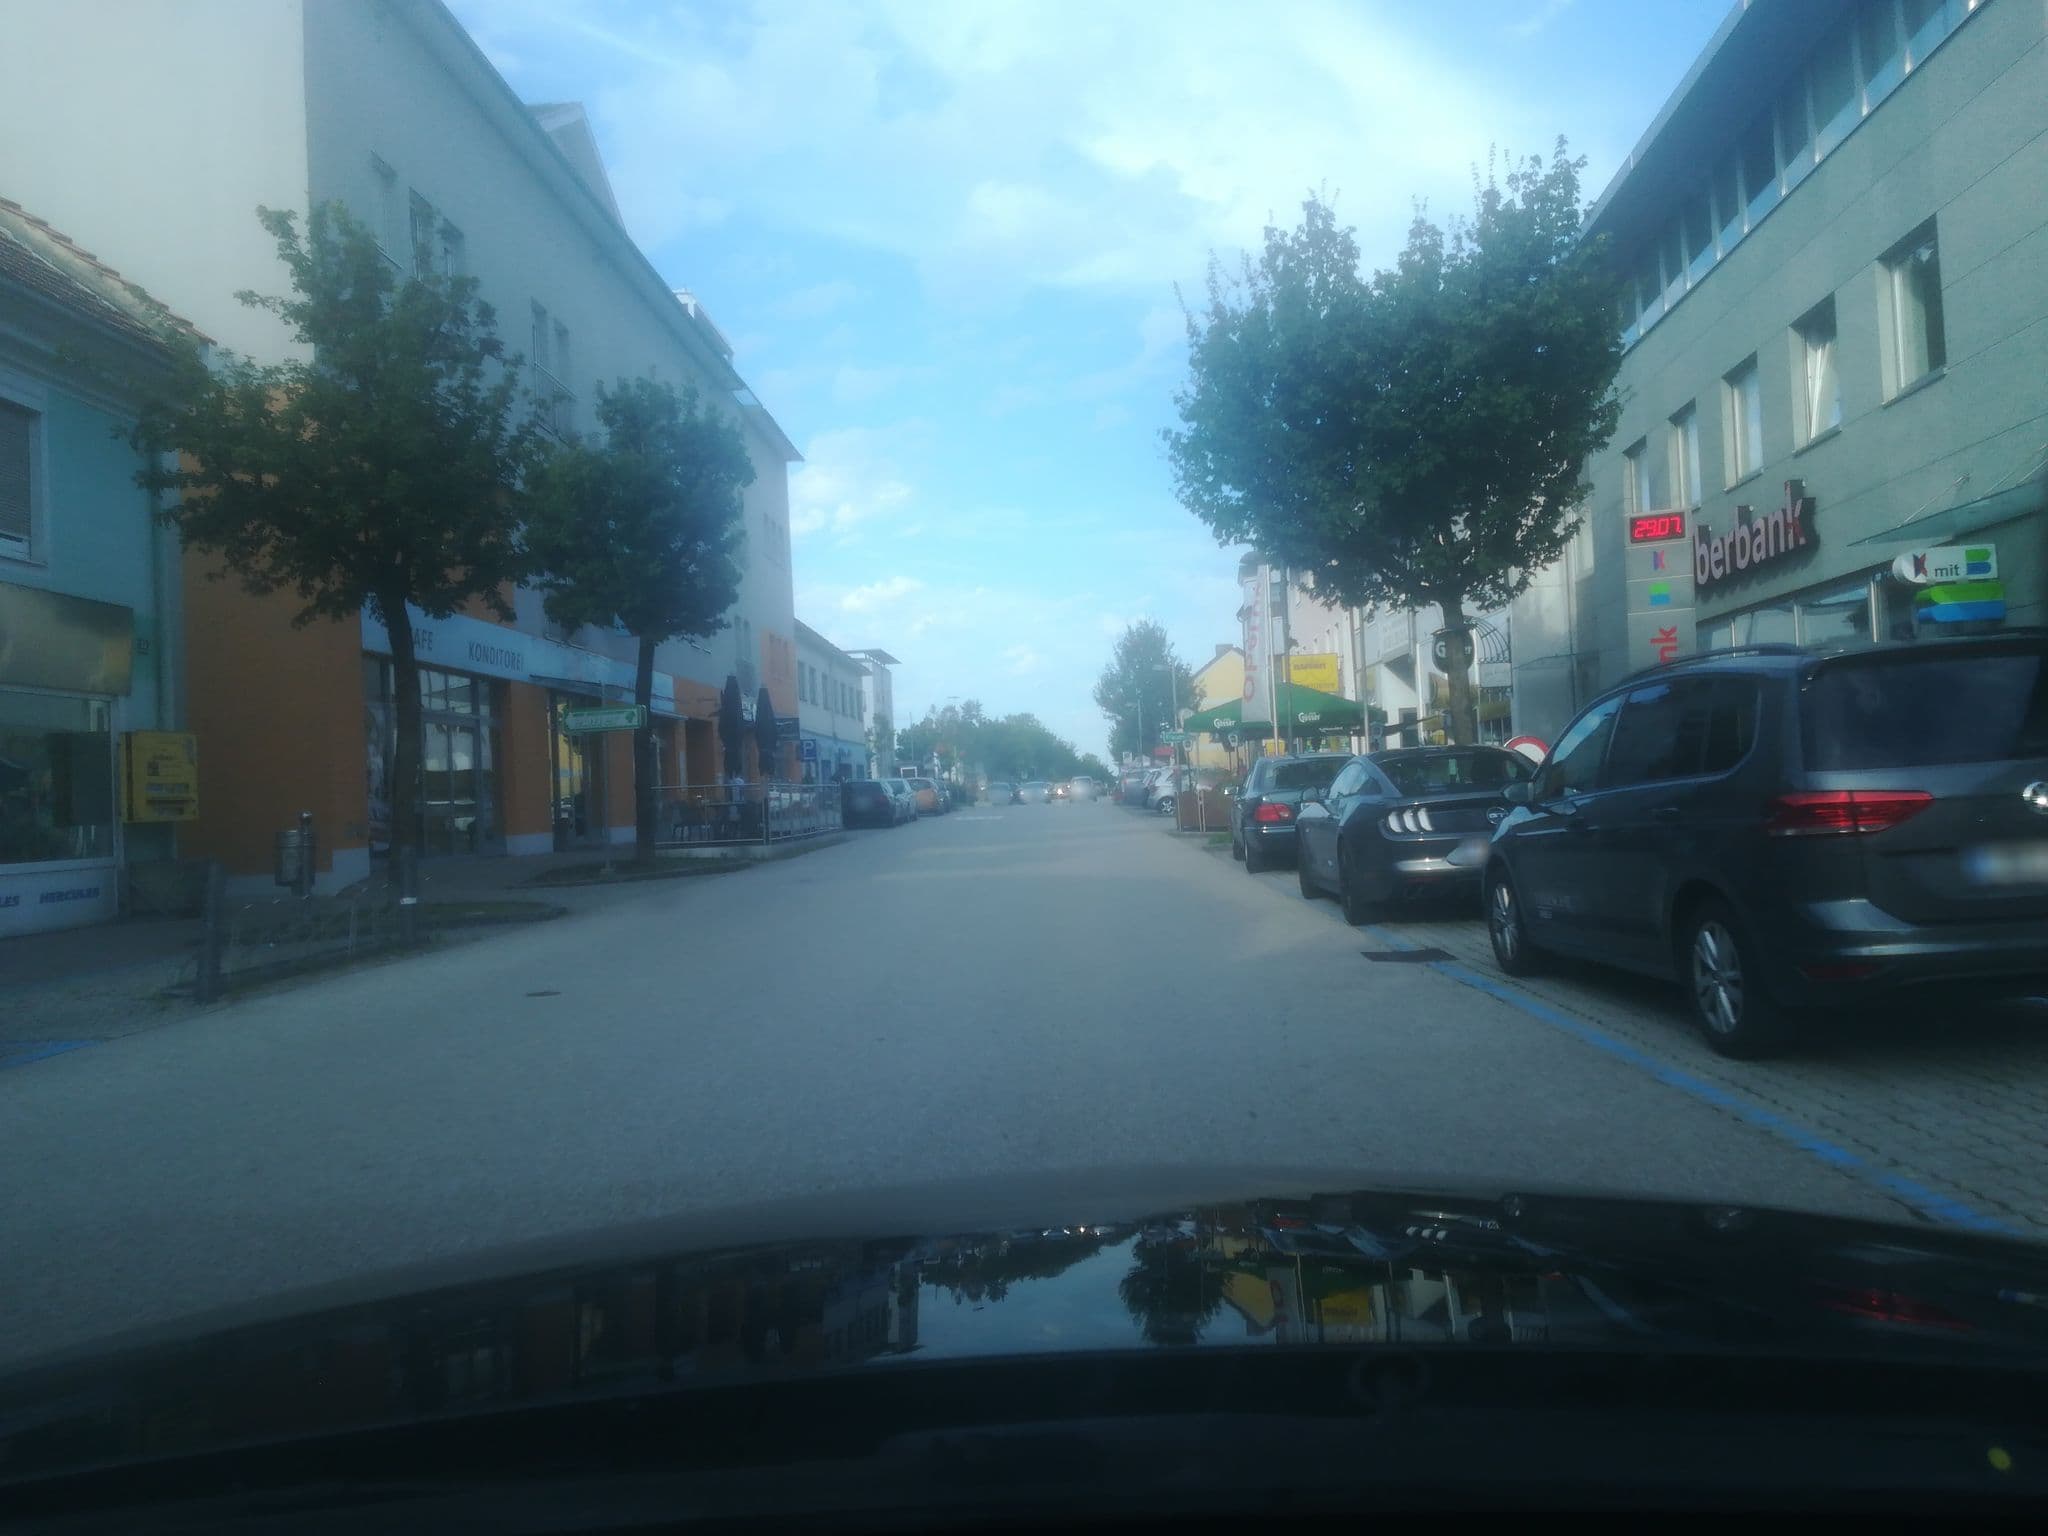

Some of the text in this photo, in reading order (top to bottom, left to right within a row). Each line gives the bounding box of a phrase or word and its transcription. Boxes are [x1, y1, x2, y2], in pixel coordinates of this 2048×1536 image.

[1694, 480, 1806, 585] berbank
[1934, 563, 1960, 577] mit
[413, 627, 433, 651] AFE
[468, 640, 524, 672] KONDITOREI
[40, 887, 100, 904] HERCULES
